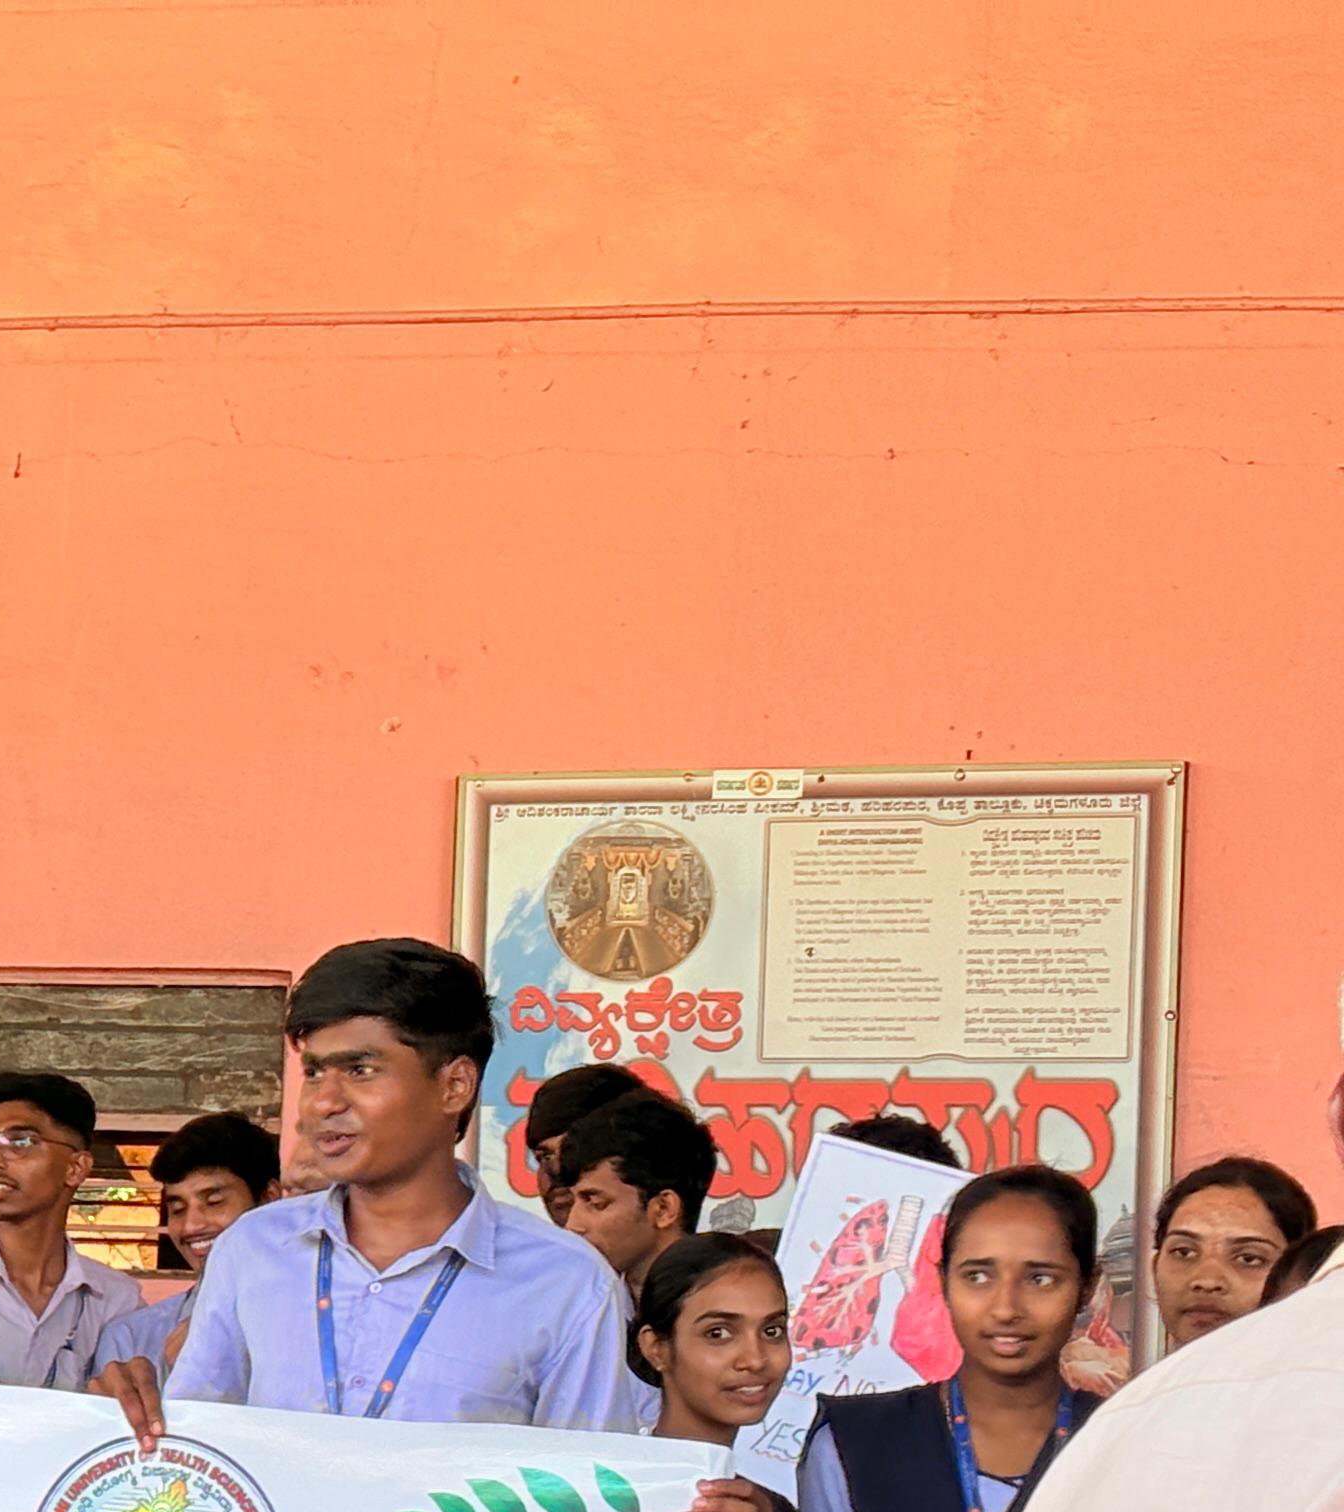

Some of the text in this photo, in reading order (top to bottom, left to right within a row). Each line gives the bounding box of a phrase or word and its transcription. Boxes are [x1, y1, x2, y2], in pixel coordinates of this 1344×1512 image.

[510, 976, 744, 1061] ದಿವ್ಯಕ್ಷೇತ್ರ
[783, 1368, 825, 1398] AY
[749, 1418, 809, 1460] YES
